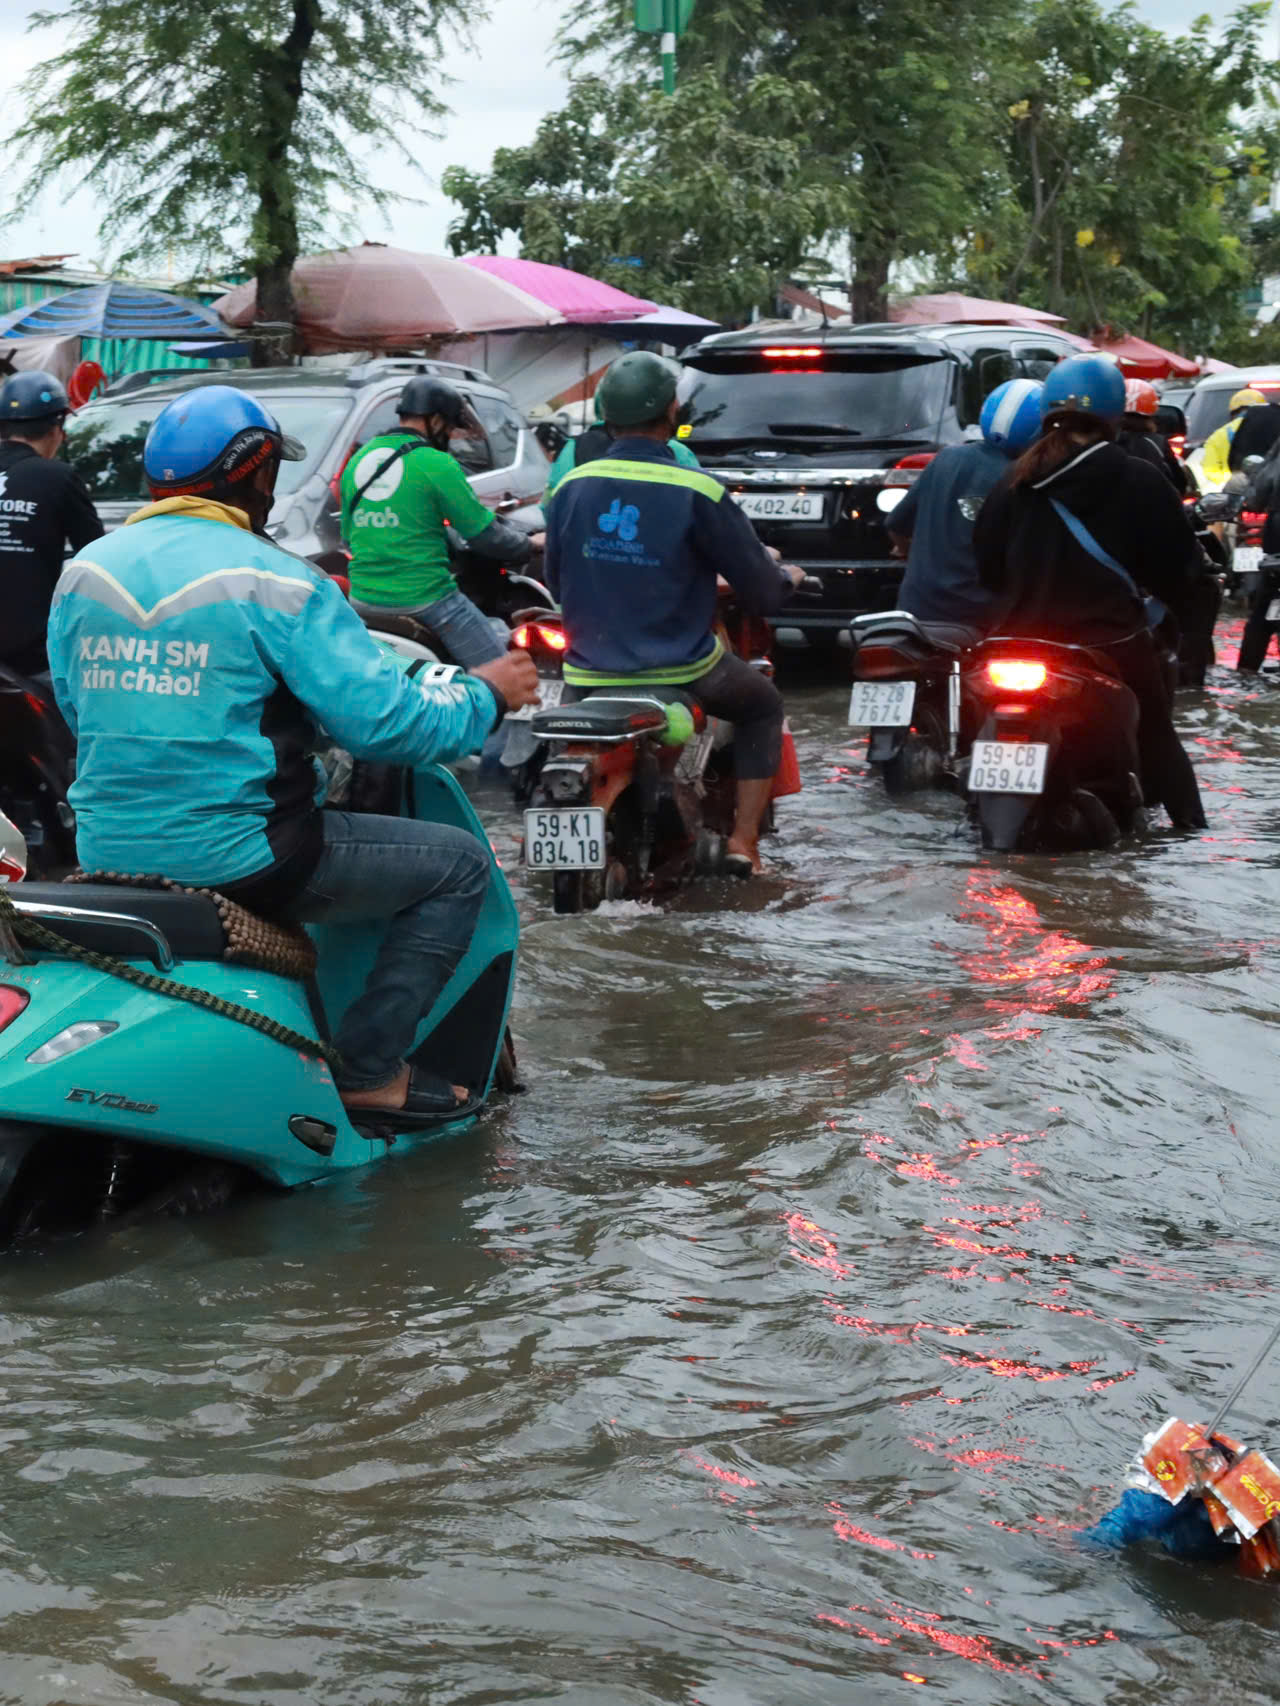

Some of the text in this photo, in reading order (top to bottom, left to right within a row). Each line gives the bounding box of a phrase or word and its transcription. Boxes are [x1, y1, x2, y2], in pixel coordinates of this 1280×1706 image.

[352, 506, 400, 528] Grab
[80, 635, 209, 668] XANH SM
[82, 663, 201, 696] xin chào!
[548, 720, 593, 728] HONDA
[857, 705, 901, 723] 7674
[981, 744, 1037, 767] 59-CB
[974, 768, 1038, 790] 059.44
[536, 813, 590, 838] 59-K1
[532, 839, 599, 864] 834.18
